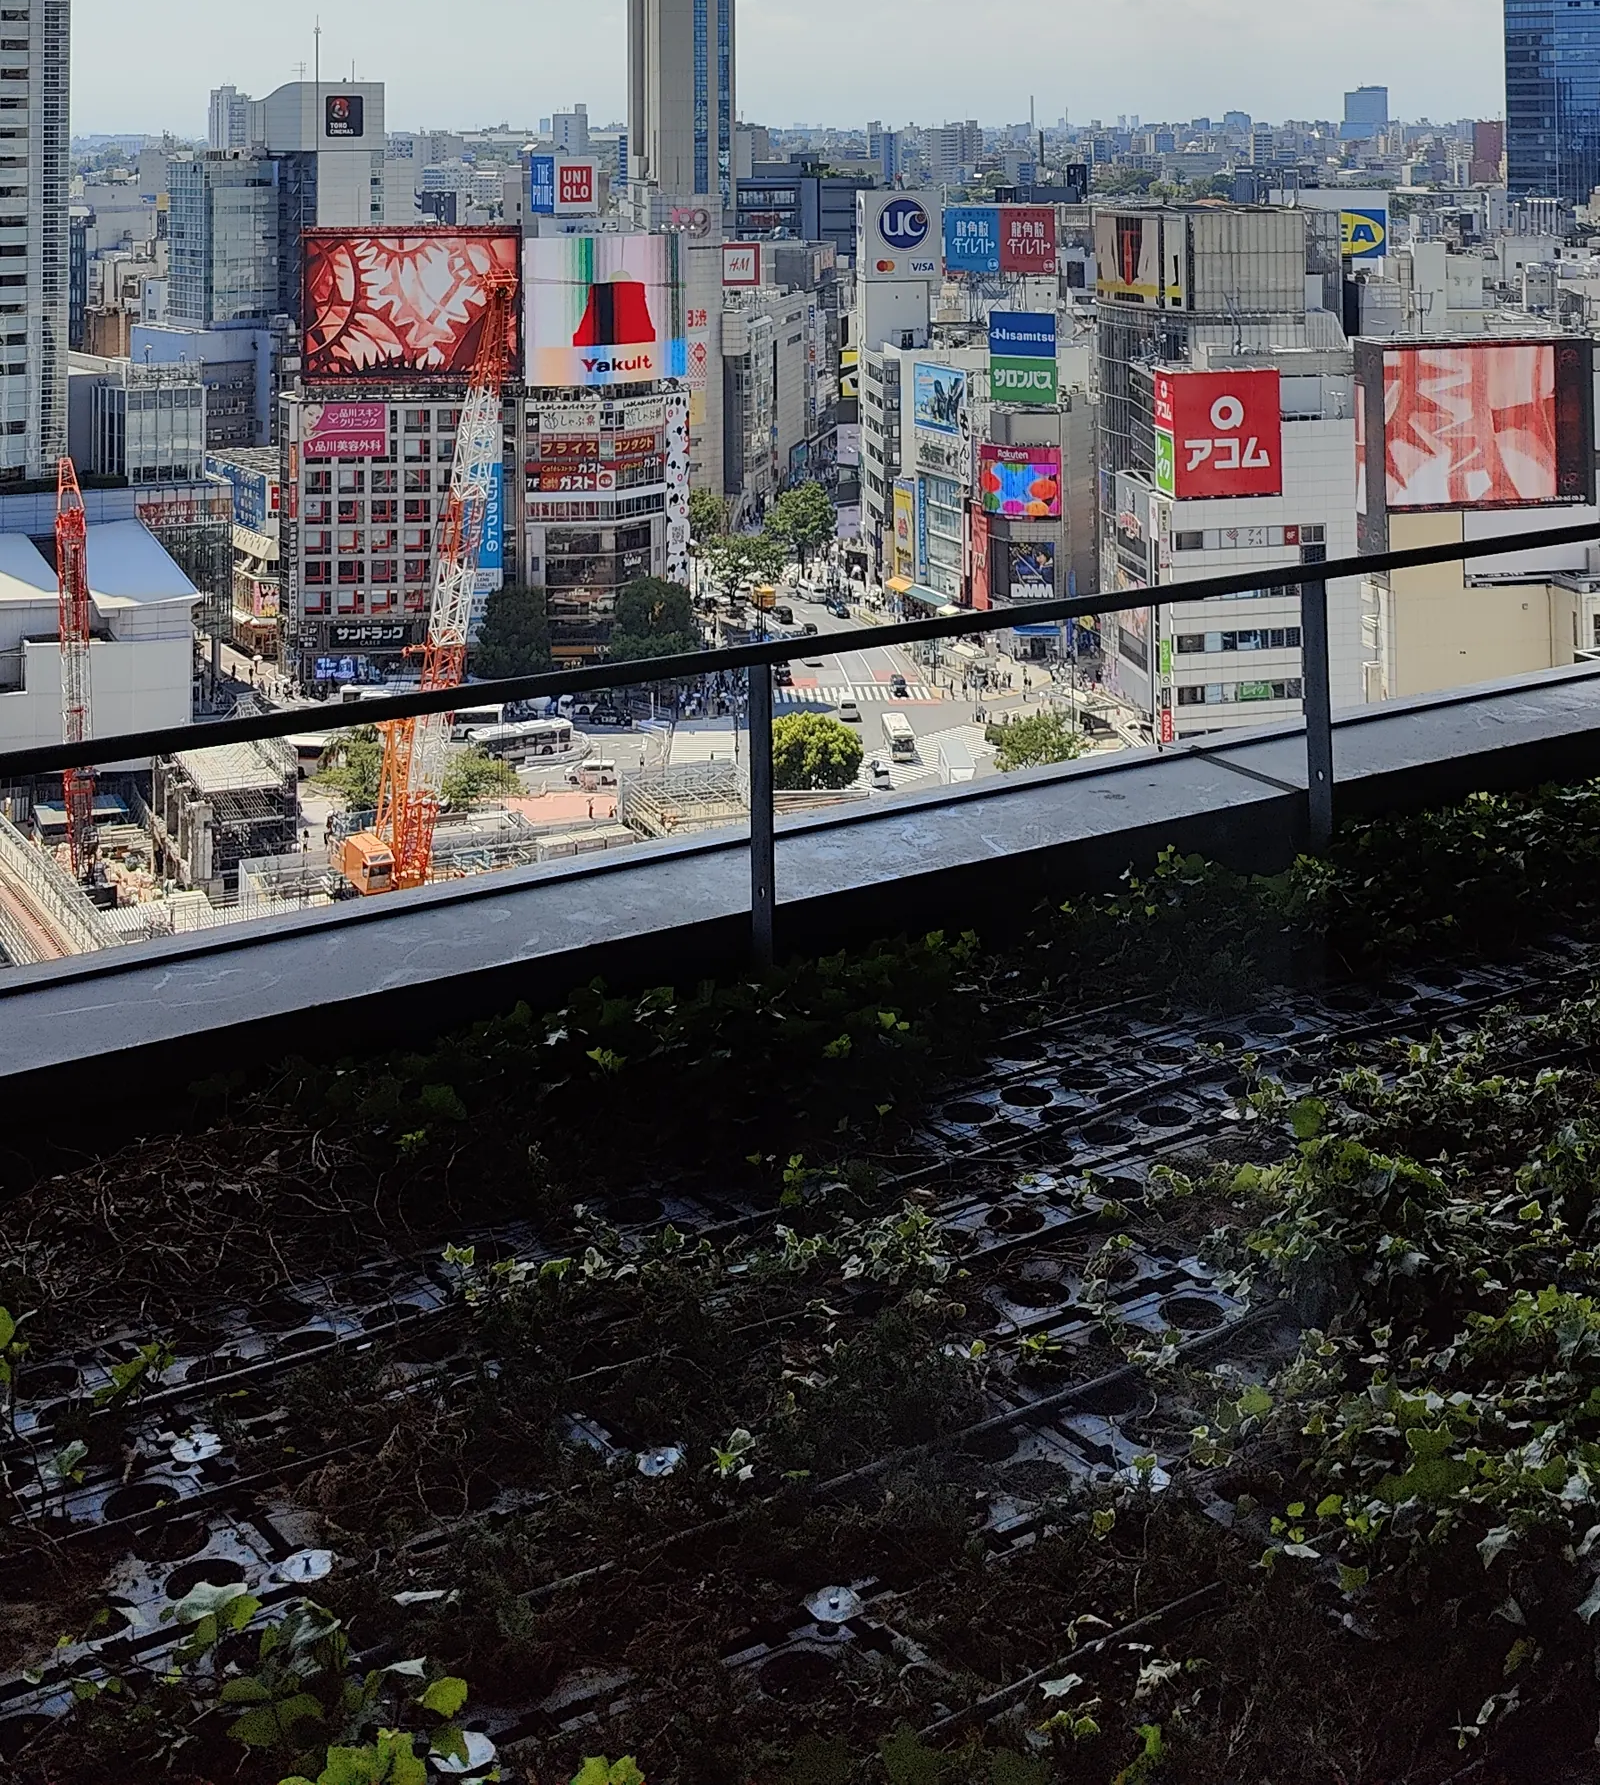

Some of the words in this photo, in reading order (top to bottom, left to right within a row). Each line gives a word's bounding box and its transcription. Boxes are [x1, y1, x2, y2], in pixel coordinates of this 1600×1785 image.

[536, 163, 550, 184] THE
[562, 170, 587, 184] UNI
[562, 185, 589, 201] QLO
[956, 221, 989, 237] 龍角散
[1011, 221, 1044, 238] 龍角散
[911, 262, 934, 271] VISA
[991, 328, 1054, 342] Hisamitsu
[581, 355, 653, 373] Yakult
[994, 369, 1052, 390] サロンパス
[339, 408, 382, 418] 品川スキン
[339, 418, 378, 427] クリニック
[527, 417, 538, 427] 9F
[314, 440, 382, 453] 品川美容外科
[615, 436, 653, 452] コンタクト
[997, 449, 1029, 460] Rakuten
[1184, 437, 1270, 472] アコム
[577, 462, 605, 474] ガスト
[526, 477, 540, 488] 7F
[560, 475, 595, 491] ガスト
[143, 516, 187, 526] MARK
[1010, 583, 1054, 598] DMM
[336, 626, 405, 640] サンドラッグ
[1242, 684, 1265, 696] レイク
